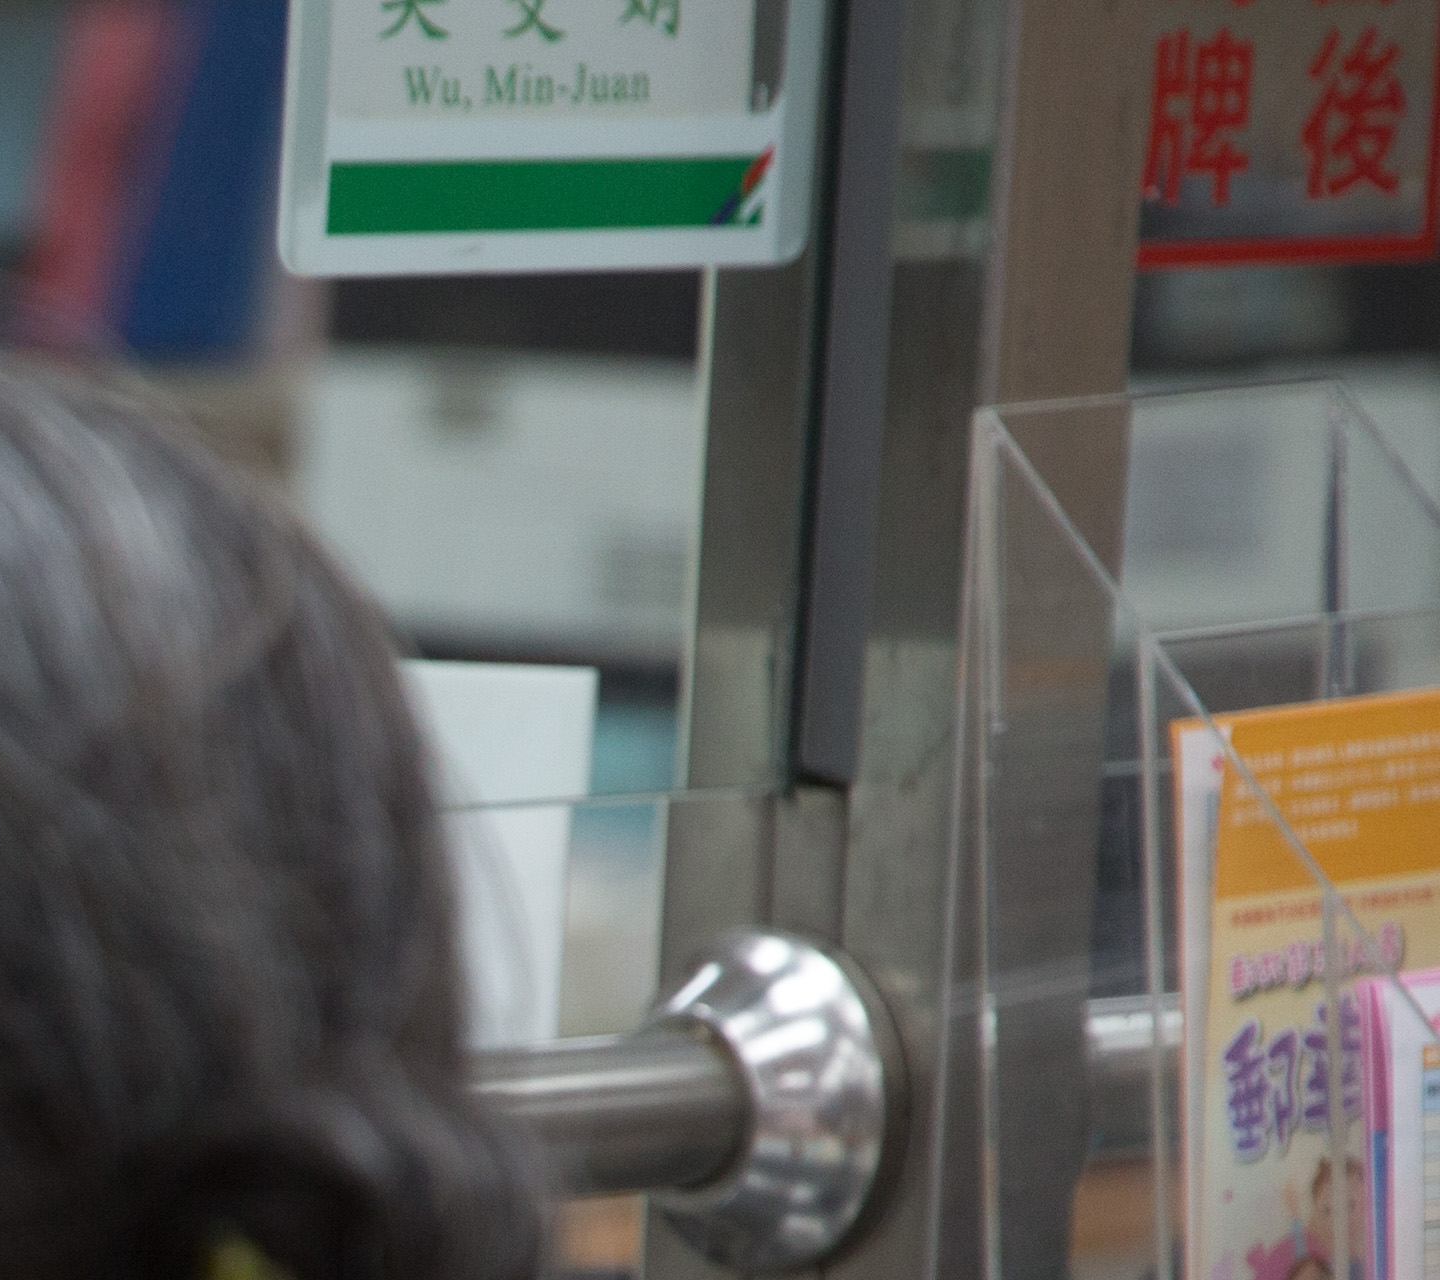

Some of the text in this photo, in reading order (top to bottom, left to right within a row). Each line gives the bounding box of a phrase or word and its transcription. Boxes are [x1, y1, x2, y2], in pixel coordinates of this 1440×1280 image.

[403, 61, 651, 112] Wu, Min-Juan
[1141, 23, 1409, 207] 牌後
